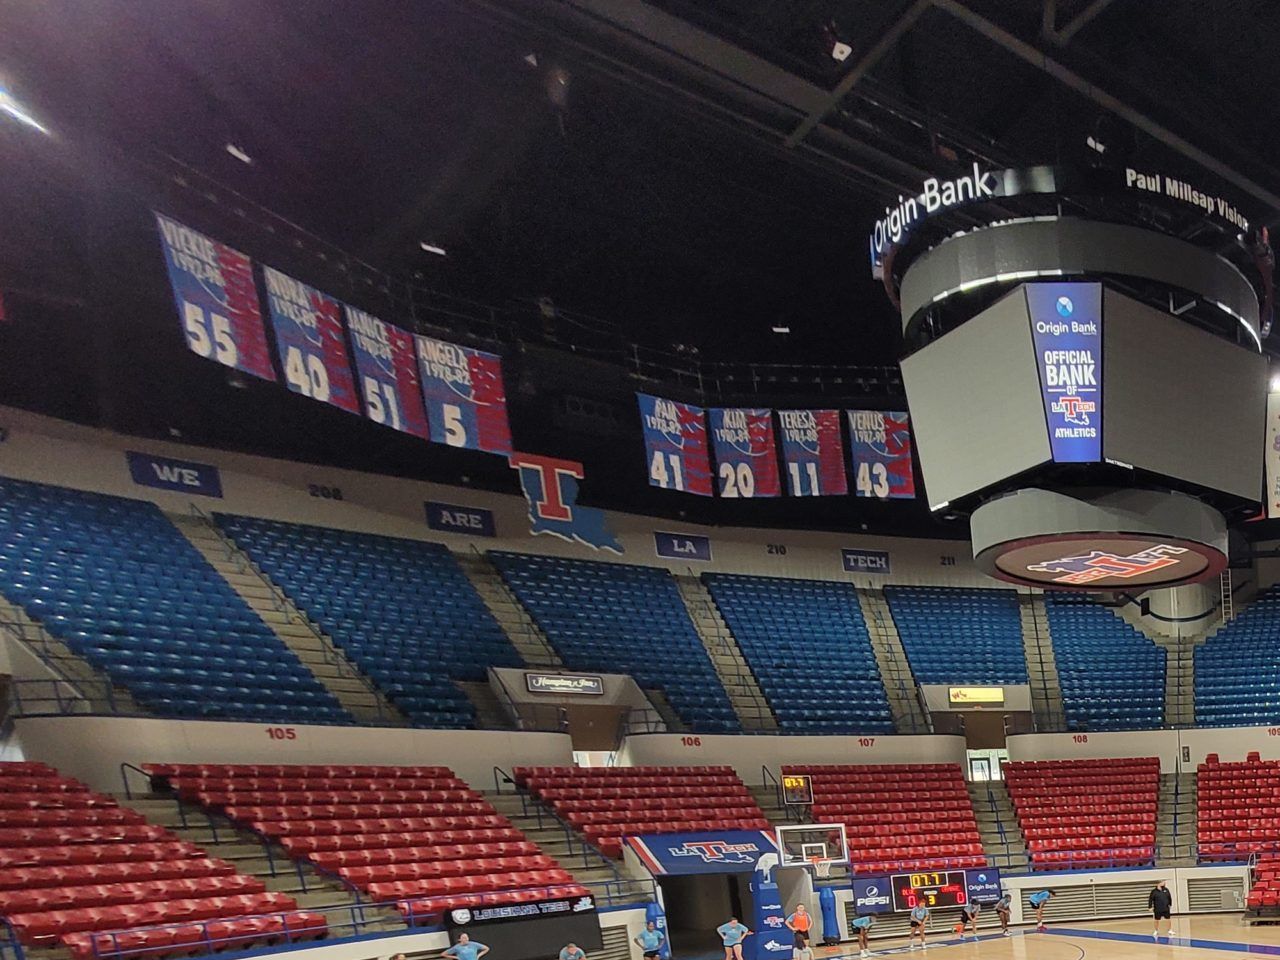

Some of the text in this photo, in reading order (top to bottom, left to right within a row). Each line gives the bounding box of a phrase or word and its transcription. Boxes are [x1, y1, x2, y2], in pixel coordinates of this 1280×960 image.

[874, 162, 993, 252] Origin Bank
[1126, 168, 1249, 230] Paul Millsap Vision
[184, 300, 238, 367] 55
[1036, 320, 1097, 336] Origin Bank
[418, 338, 468, 369] ANGELA
[1044, 350, 1095, 364] OFFICIAL
[286, 346, 330, 401] 40
[1045, 365, 1097, 386] BANK
[1066, 386, 1078, 395] OF
[365, 376, 400, 430] 51
[443, 403, 467, 447] 5
[723, 408, 748, 428] KIM
[779, 411, 817, 429] TERESA
[847, 411, 886, 430] VENUS
[1055, 427, 1097, 438] ATHLETICS
[152, 462, 199, 487] WE
[651, 450, 684, 491] 41
[720, 462, 754, 497] 20
[788, 462, 819, 497] 11
[857, 462, 889, 498] 43
[441, 510, 483, 529] ARE
[673, 540, 696, 554] LA
[766, 544, 787, 555] 210
[847, 554, 888, 569] TECH
[940, 556, 956, 566] 211
[266, 727, 296, 740] 105
[681, 737, 700, 748] 106
[1072, 734, 1088, 744] 108
[858, 738, 875, 748] 107
[683, 841, 759, 858] TECH
[912, 873, 940, 887] 07.7
[985, 882, 998, 890] Bank
[857, 896, 890, 907] PEPSI
[908, 896, 917, 907] 0
[928, 896, 936, 905] 3
[957, 892, 965, 904] 0
[473, 905, 540, 920] LOUISIANA
[539, 901, 571, 914] TECH
